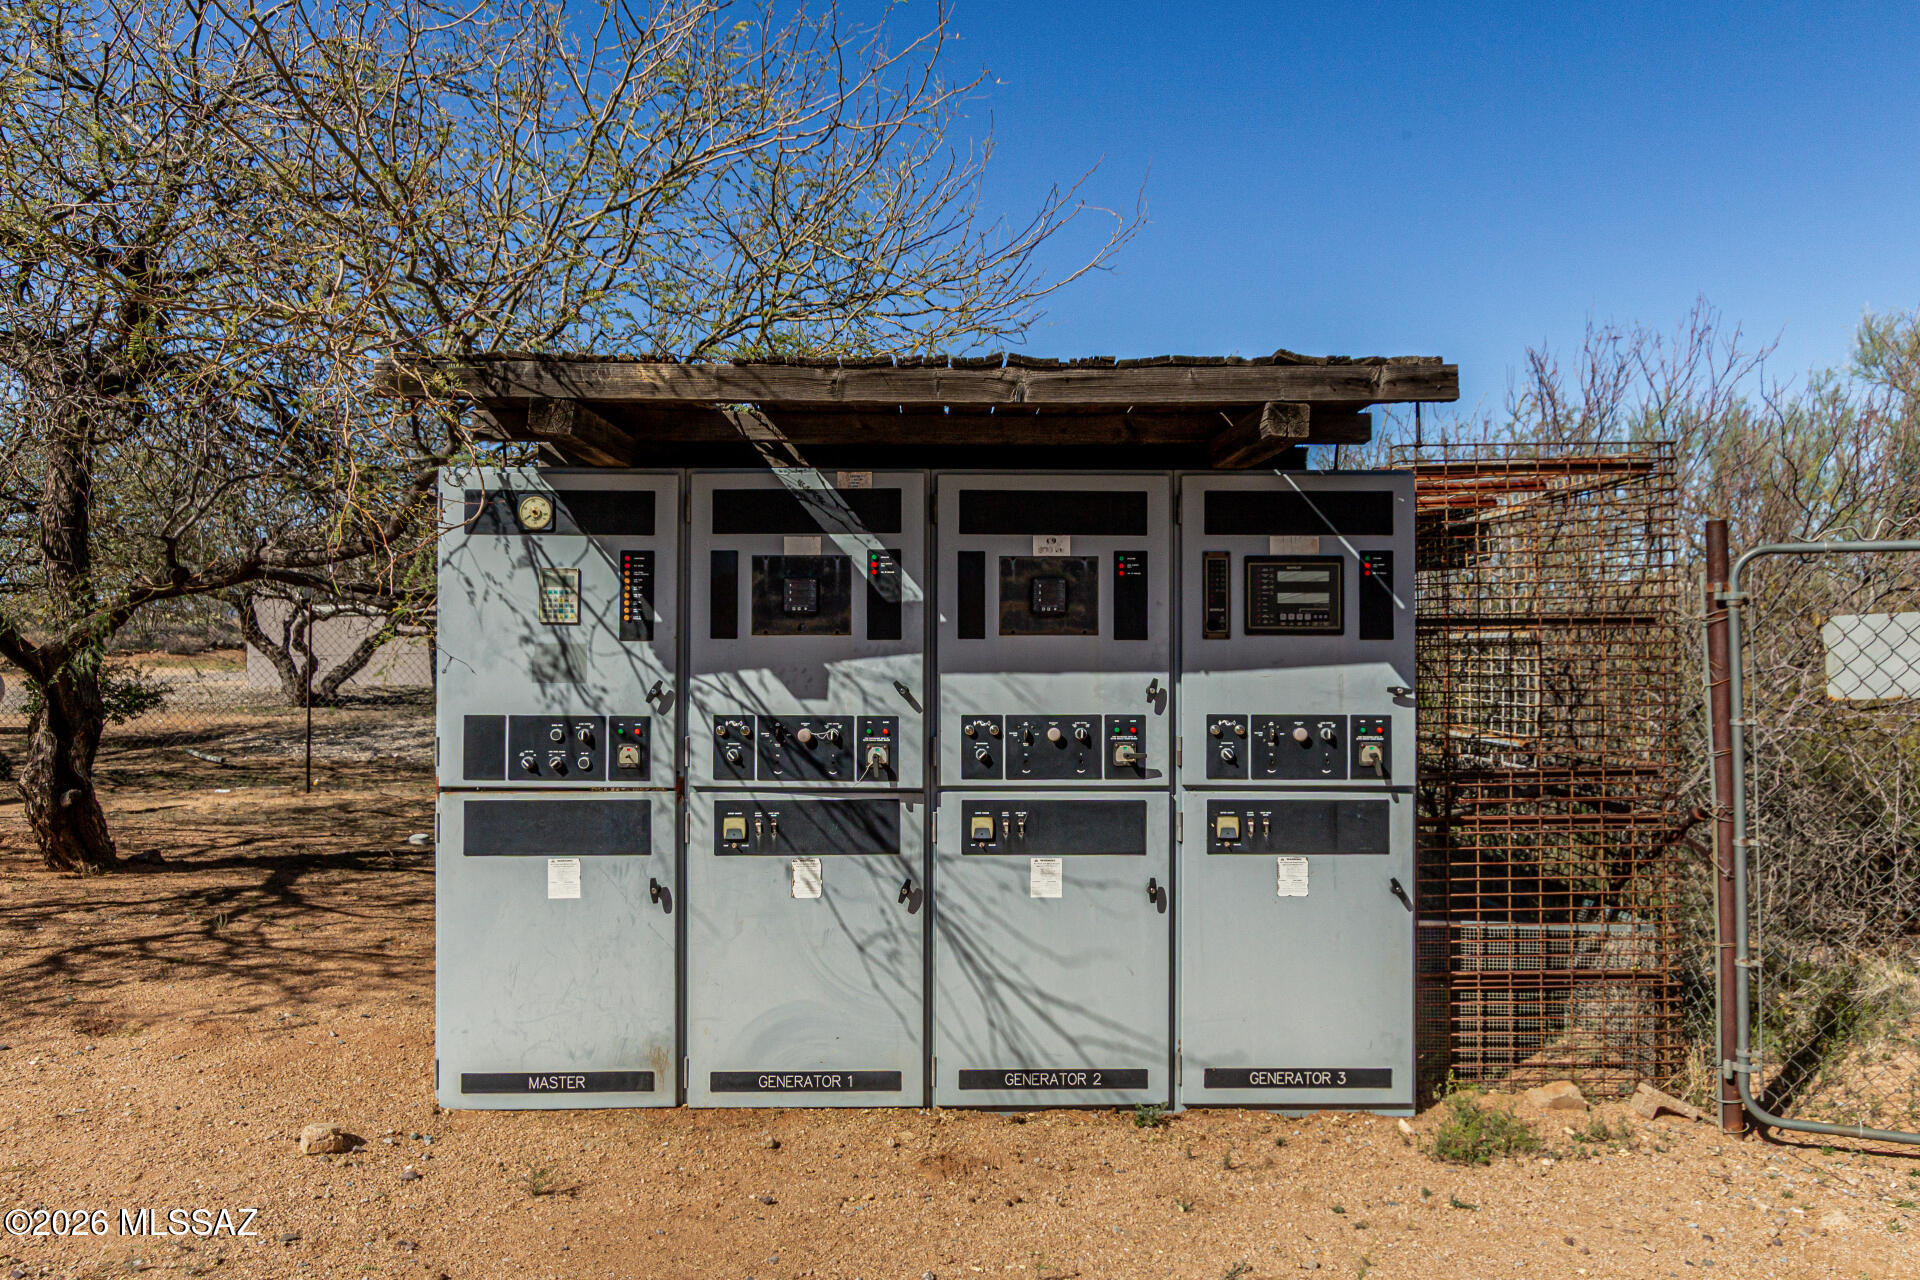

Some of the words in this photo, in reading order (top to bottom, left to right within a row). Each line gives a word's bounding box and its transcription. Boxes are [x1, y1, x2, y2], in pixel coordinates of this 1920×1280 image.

[527, 1075, 586, 1090] MASTER
[758, 1074, 841, 1088] GENERATOR
[847, 1075, 853, 1088] 1
[1004, 1072, 1088, 1086] GENERATOR
[1092, 1072, 1103, 1086] 2
[1249, 1071, 1332, 1085] GENERATOR
[1337, 1071, 1347, 1085] 3
